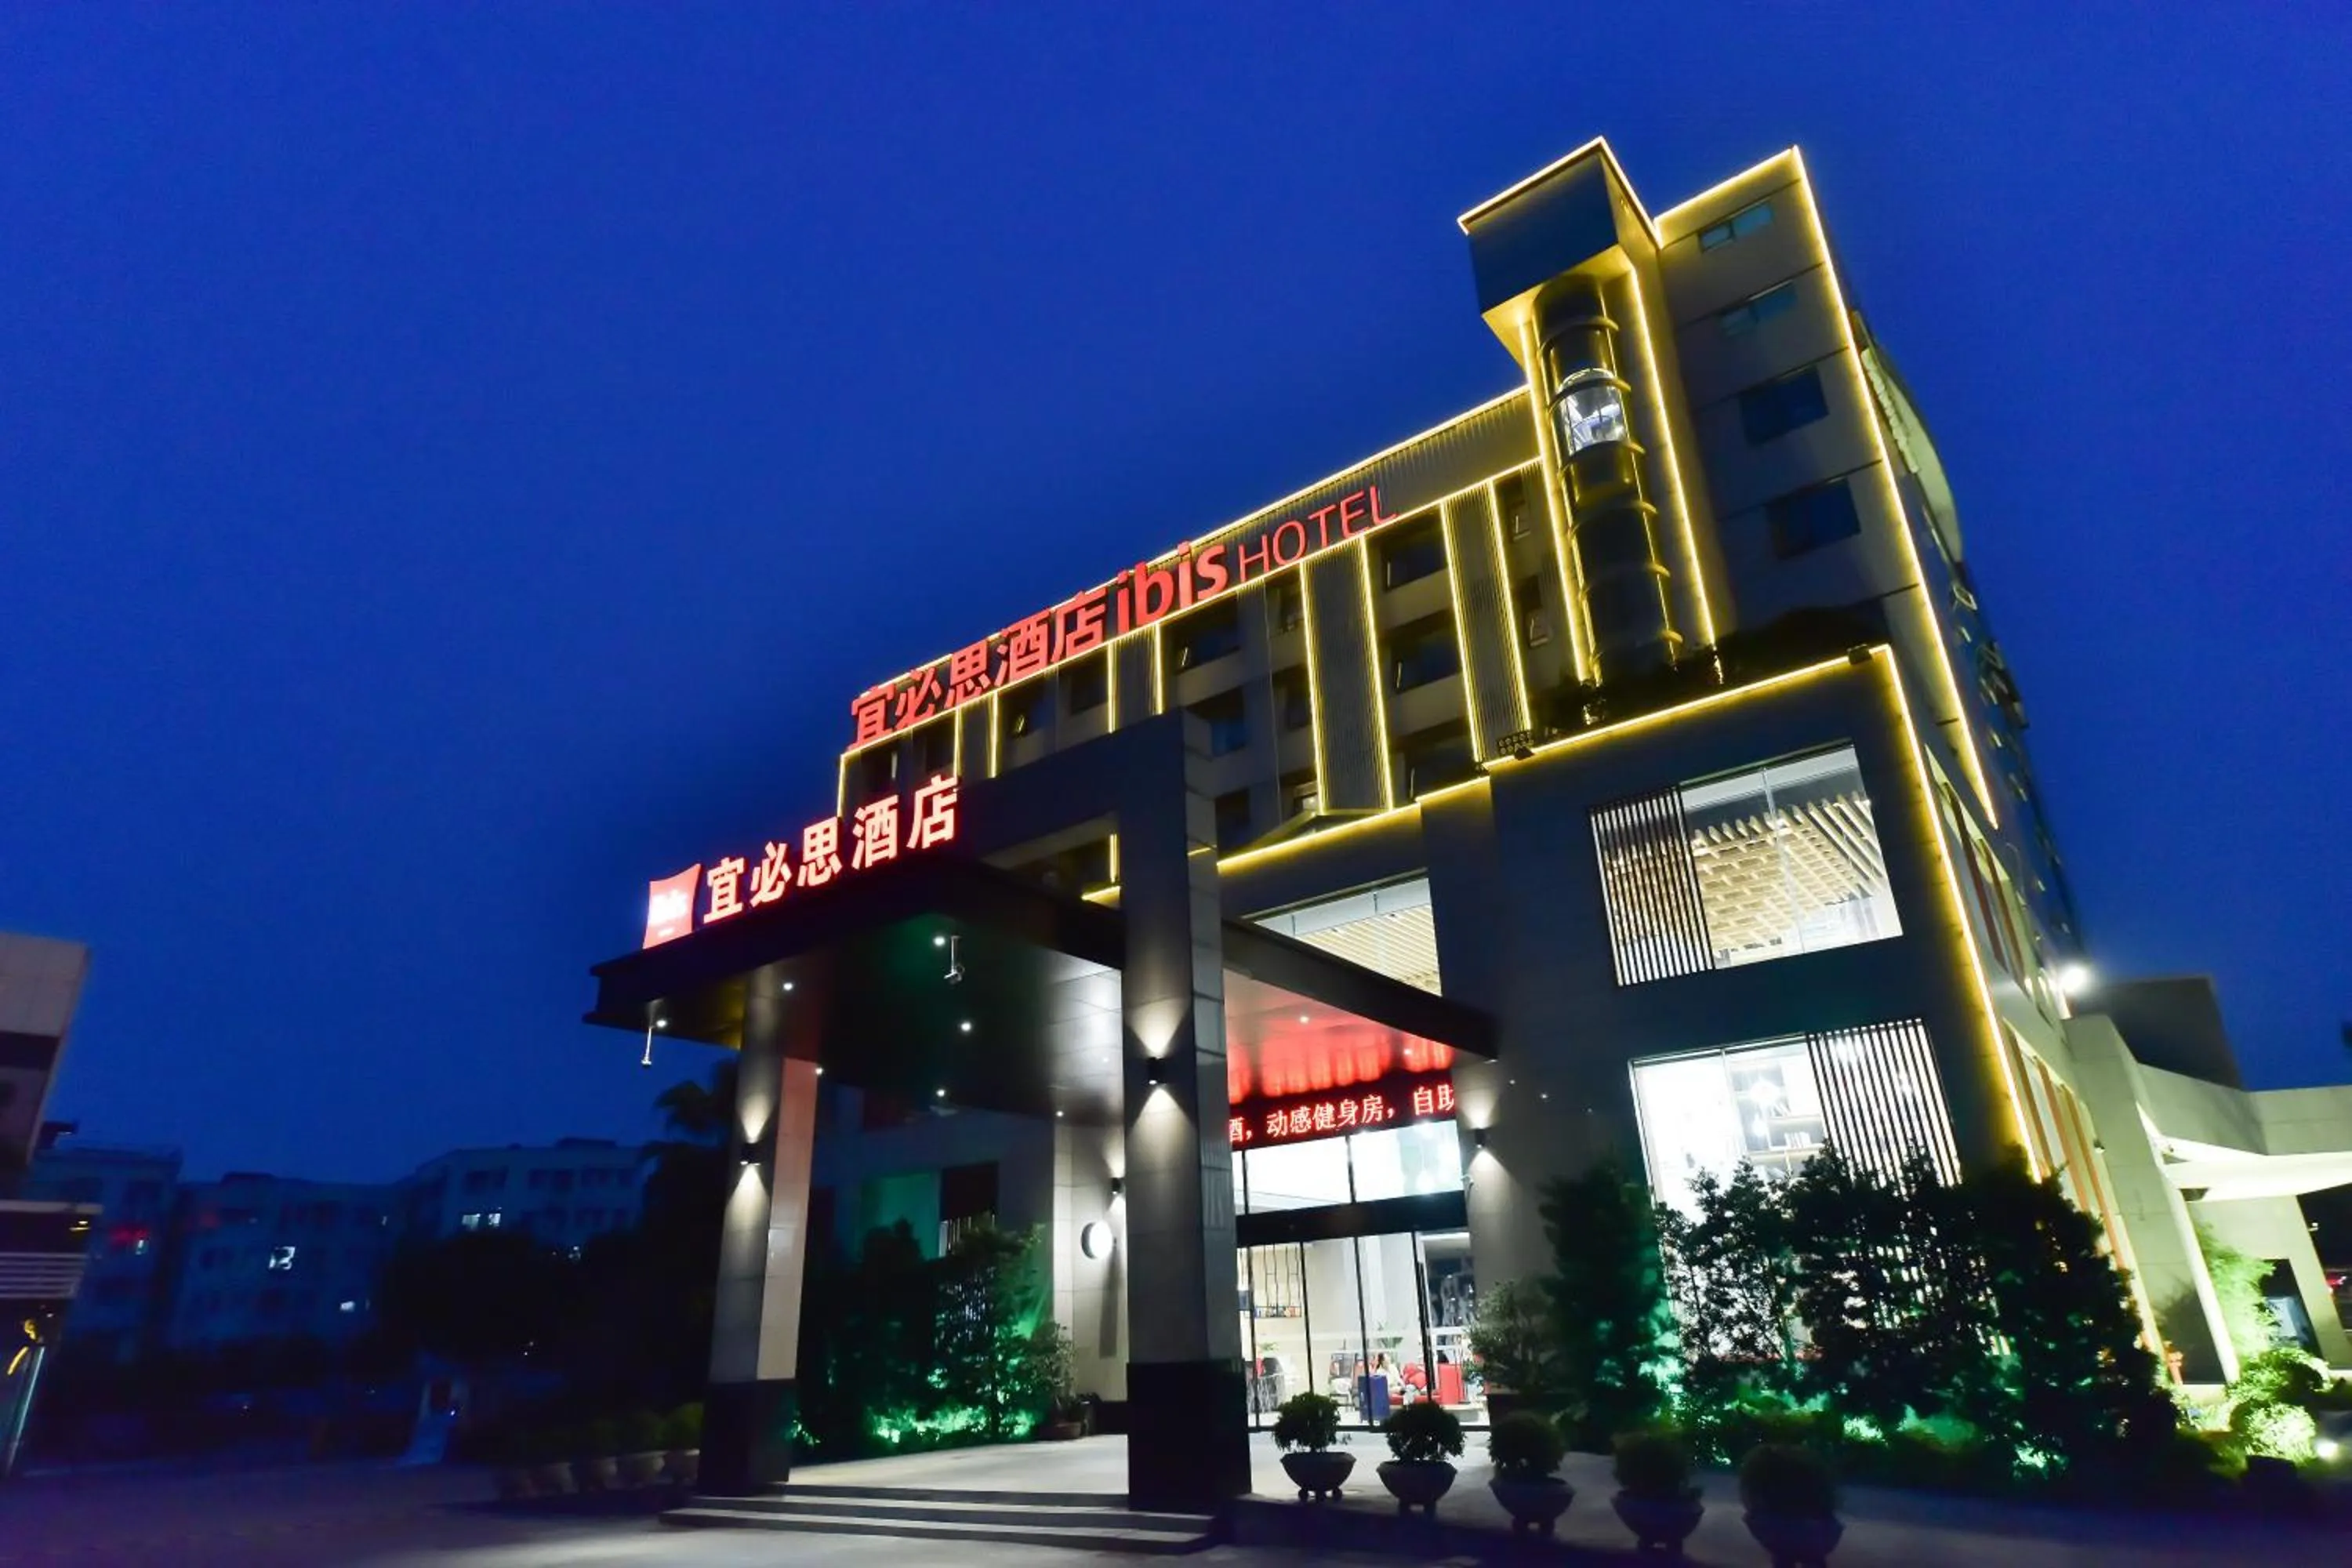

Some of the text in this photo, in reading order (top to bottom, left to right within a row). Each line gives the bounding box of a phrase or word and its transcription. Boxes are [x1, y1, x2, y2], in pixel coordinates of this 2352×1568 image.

[850, 485, 1397, 750] 宜必思酒店 ibis HOTEL
[703, 775, 959, 924] 宜必思酒店
